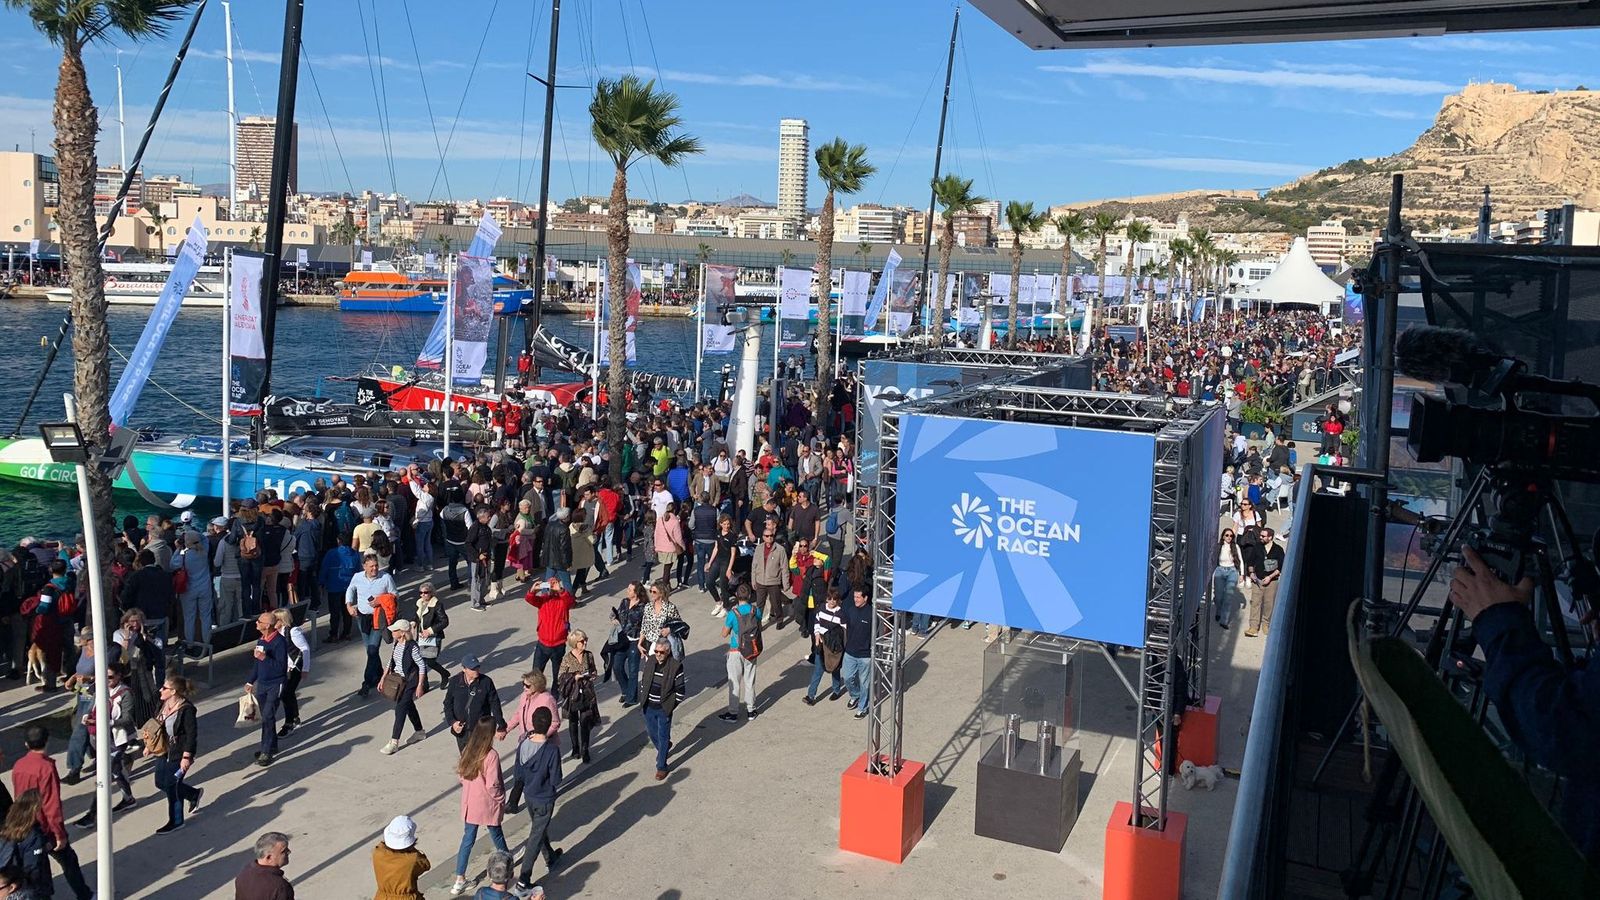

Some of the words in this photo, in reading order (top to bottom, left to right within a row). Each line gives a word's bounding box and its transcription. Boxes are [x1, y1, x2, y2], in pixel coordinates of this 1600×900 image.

[282, 403, 325, 417] RACE
[20, 466, 36, 478] GO
[998, 496, 1036, 516] THE
[997, 515, 1080, 543] OCEAN
[997, 535, 1051, 557] RACE
